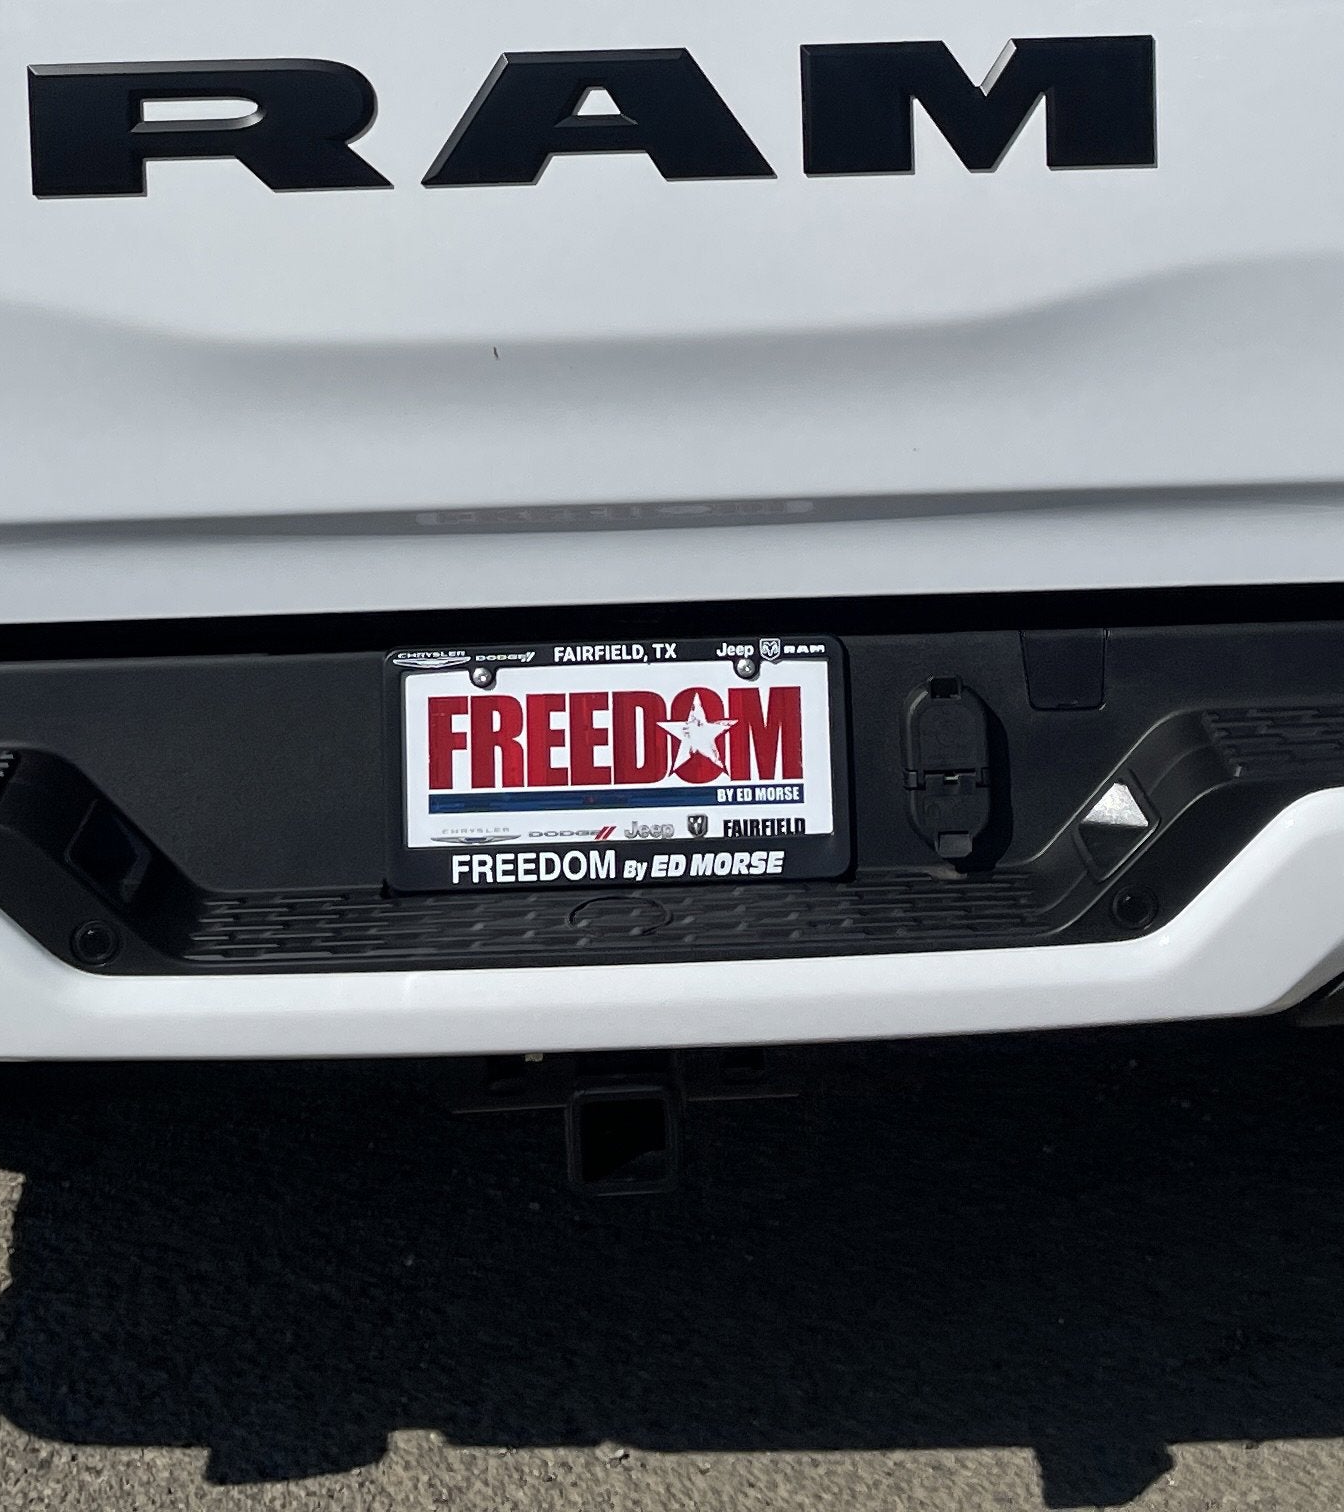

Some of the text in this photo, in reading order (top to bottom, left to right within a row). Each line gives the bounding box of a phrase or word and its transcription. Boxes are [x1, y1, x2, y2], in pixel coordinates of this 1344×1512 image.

[27, 35, 1157, 199] RAM
[397, 649, 466, 659] CHRYSLER
[475, 653, 526, 662] DODGE
[553, 642, 677, 663] FAIRFIELD, TX
[716, 642, 754, 658] Jeep
[783, 644, 825, 654] RAM
[427, 685, 804, 790] FREEDOM
[717, 785, 800, 802] BY ED MORSE
[528, 829, 600, 838] DODGE
[624, 819, 675, 839] Jeep
[723, 816, 806, 838] FAIRFIELD
[451, 849, 785, 884] FREEDOM By ED MORSE
